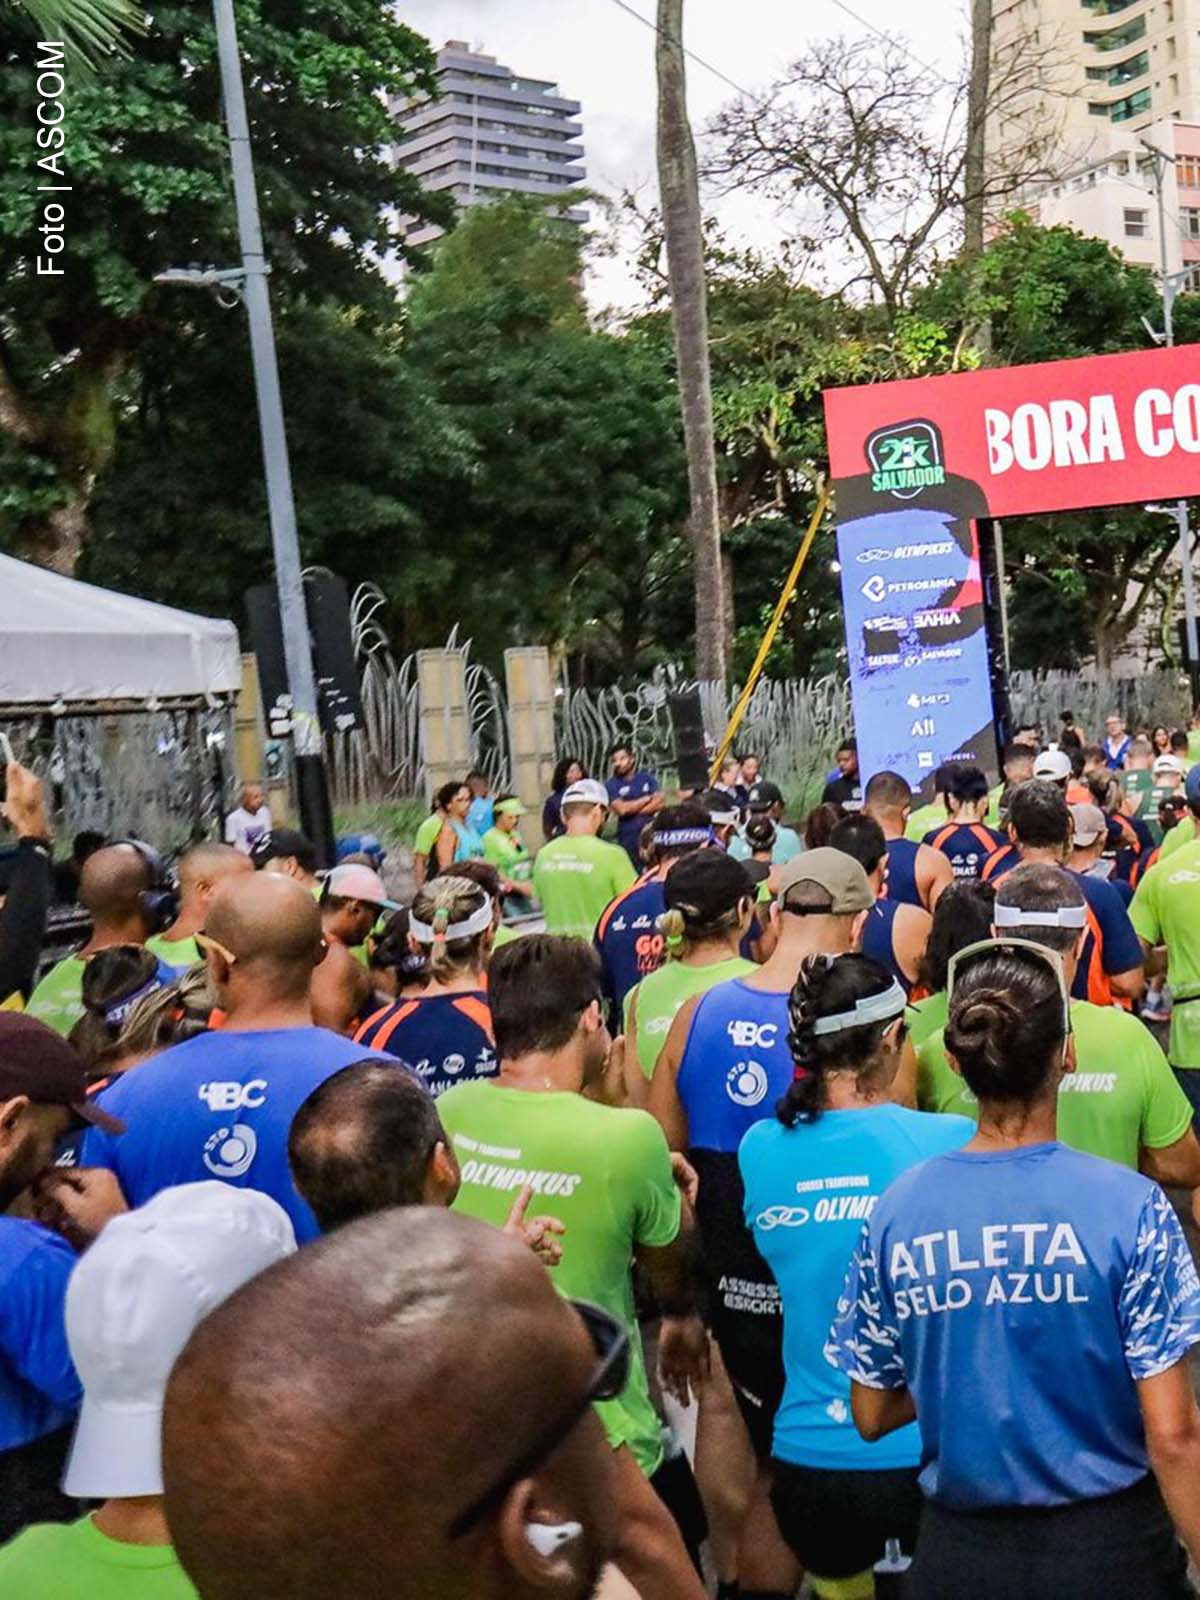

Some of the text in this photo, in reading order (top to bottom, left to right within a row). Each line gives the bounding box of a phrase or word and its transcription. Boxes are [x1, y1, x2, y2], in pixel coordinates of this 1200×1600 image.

[985, 394, 1126, 475] BORA
[871, 466, 945, 492] SALVADOR
[1058, 1072, 1118, 1094] PIKUS
[461, 1160, 582, 1197] OLYMPIKUS
[889, 1222, 1088, 1283] ATLETA
[894, 1272, 1089, 1321] SELO AZUL
